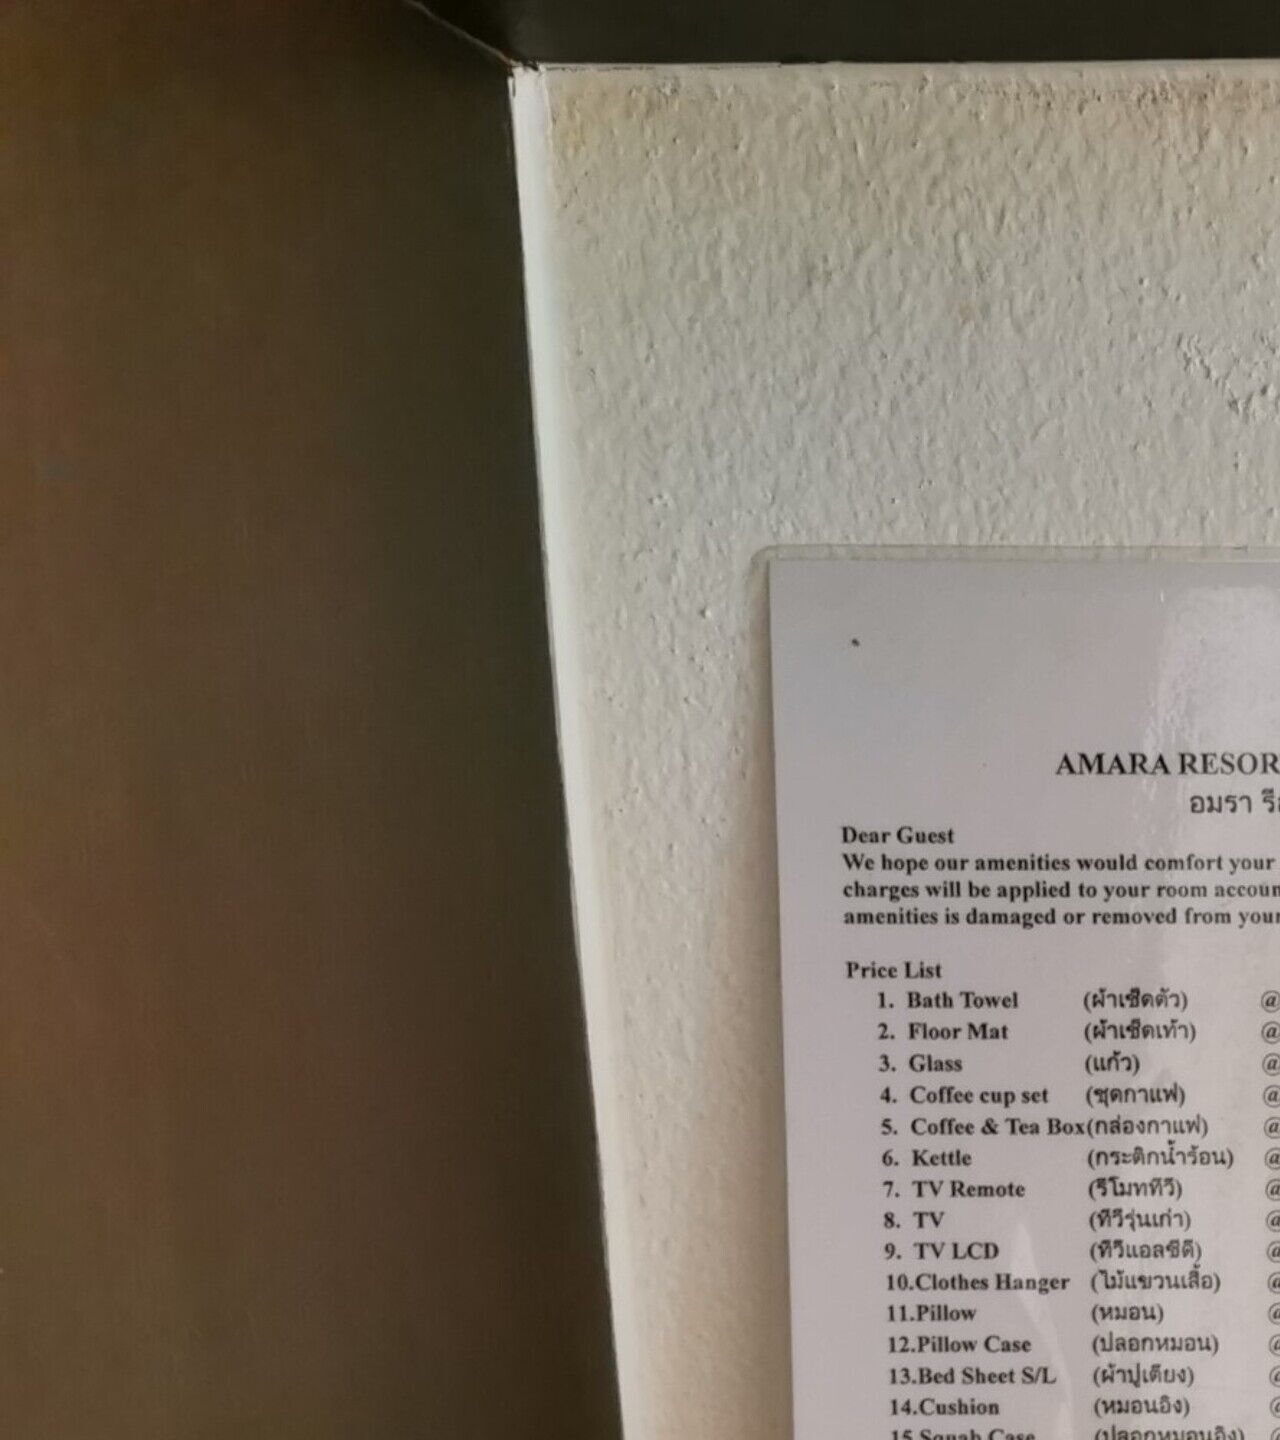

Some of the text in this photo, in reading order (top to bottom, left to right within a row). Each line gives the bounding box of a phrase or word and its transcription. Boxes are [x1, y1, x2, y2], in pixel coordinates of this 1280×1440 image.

[1055, 752, 1171, 775] AMARA
[1190, 795, 1252, 814] อมรา
[841, 826, 954, 844] Dear Guest
[842, 853, 874, 871] We
[881, 853, 928, 876] hope
[934, 858, 969, 871] our
[975, 853, 1070, 871] amenities
[1076, 854, 1137, 871] would
[1144, 853, 1223, 871] comfort
[1229, 858, 1276, 875] your
[843, 880, 919, 903] charges
[925, 880, 961, 898] will
[968, 880, 991, 898] be
[997, 880, 1070, 903] applied
[1078, 883, 1097, 898] to
[1103, 885, 1150, 903] your
[1157, 885, 1207, 898] room
[844, 907, 938, 925] amenities
[945, 907, 960, 925] is
[965, 907, 1056, 930] damaged
[1063, 912, 1086, 925] or
[1092, 907, 1177, 925] removed
[1185, 907, 1231, 924] from
[846, 961, 942, 979] Price List
[907, 991, 954, 1009] Bath
[959, 991, 1018, 1009] Towel
[909, 1022, 962, 1040] Floor
[967, 1022, 1008, 1040] Mat
[909, 1054, 963, 1072] Glass
[909, 1085, 1048, 1108] Coffee cup set
[911, 1118, 1085, 1136] Coffee & Tea Box
[912, 1149, 972, 1167] Kettle
[912, 1180, 1025, 1198] TV Remote
[913, 1211, 945, 1229] TV
[913, 1242, 999, 1260] TV LCD
[887, 1273, 1070, 1295] 10.Clothes Hanger
[888, 1304, 976, 1322] 11.Pillow
[889, 1335, 1032, 1353] 12.Pillow Case
[890, 1366, 1057, 1385] 13.Bed Sheet S/L
[891, 1398, 1000, 1416] 14.Cushion
